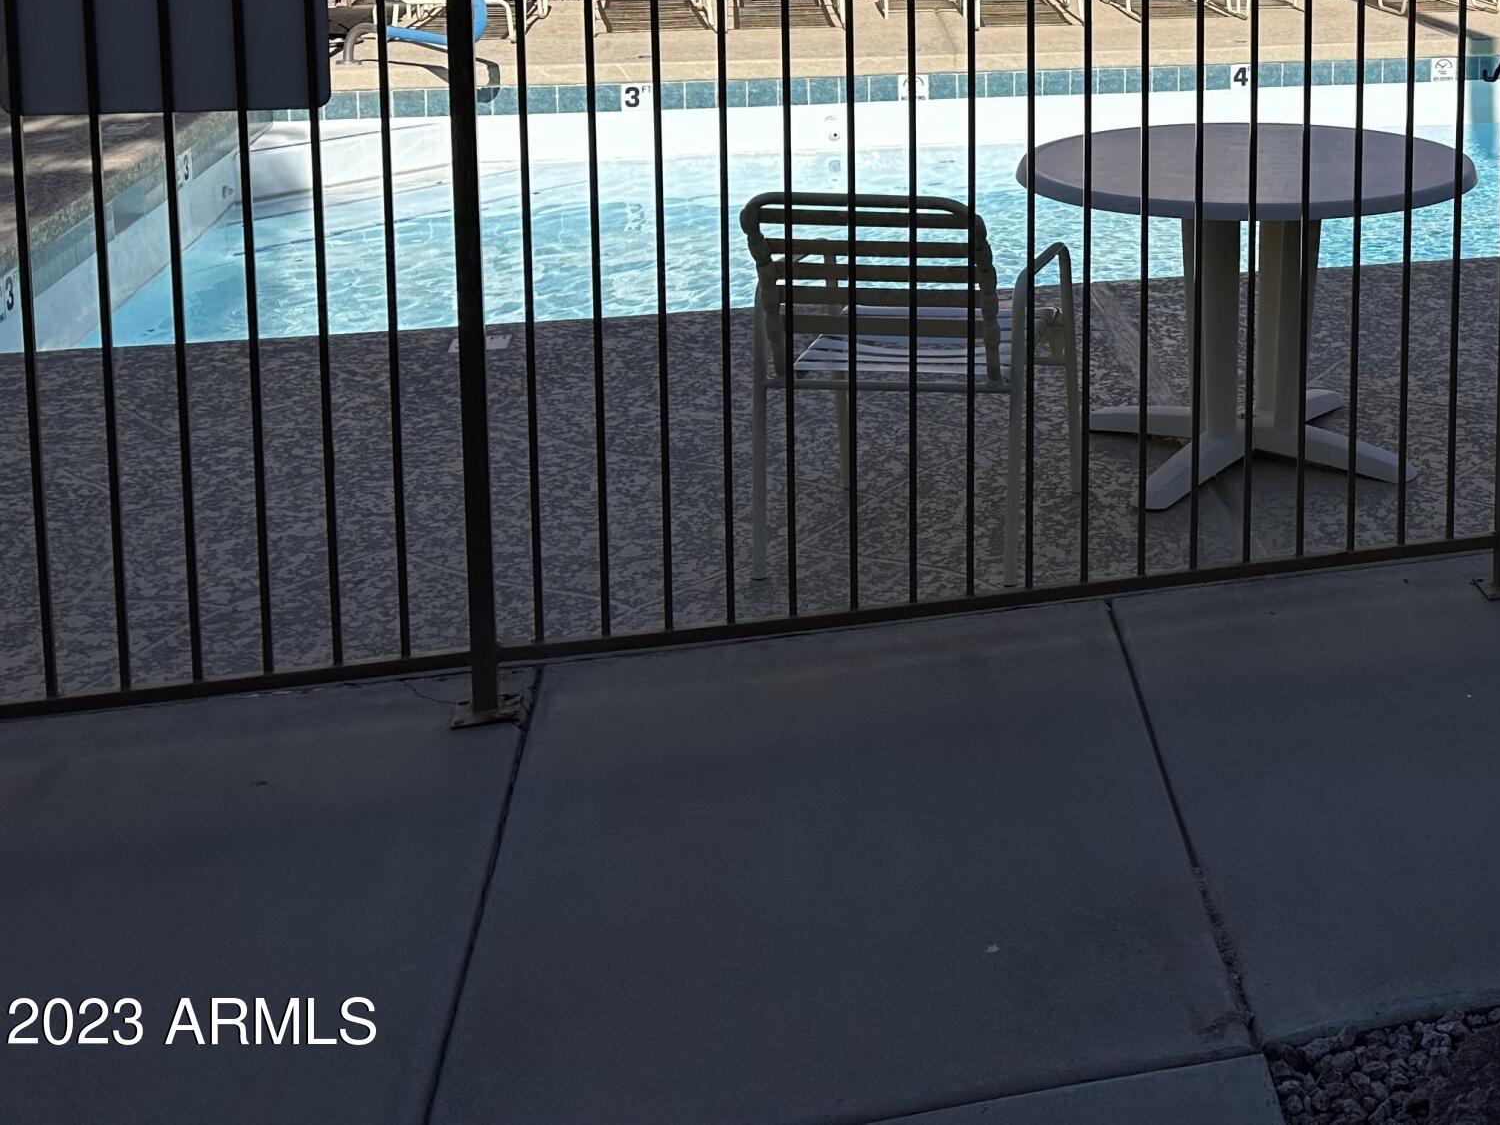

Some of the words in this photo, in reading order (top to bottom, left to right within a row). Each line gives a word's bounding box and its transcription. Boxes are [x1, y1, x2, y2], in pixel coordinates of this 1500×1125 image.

[1233, 67, 1248, 86] 4
[624, 86, 640, 107] 3
[183, 154, 189, 181] 3
[5, 276, 15, 311] 3
